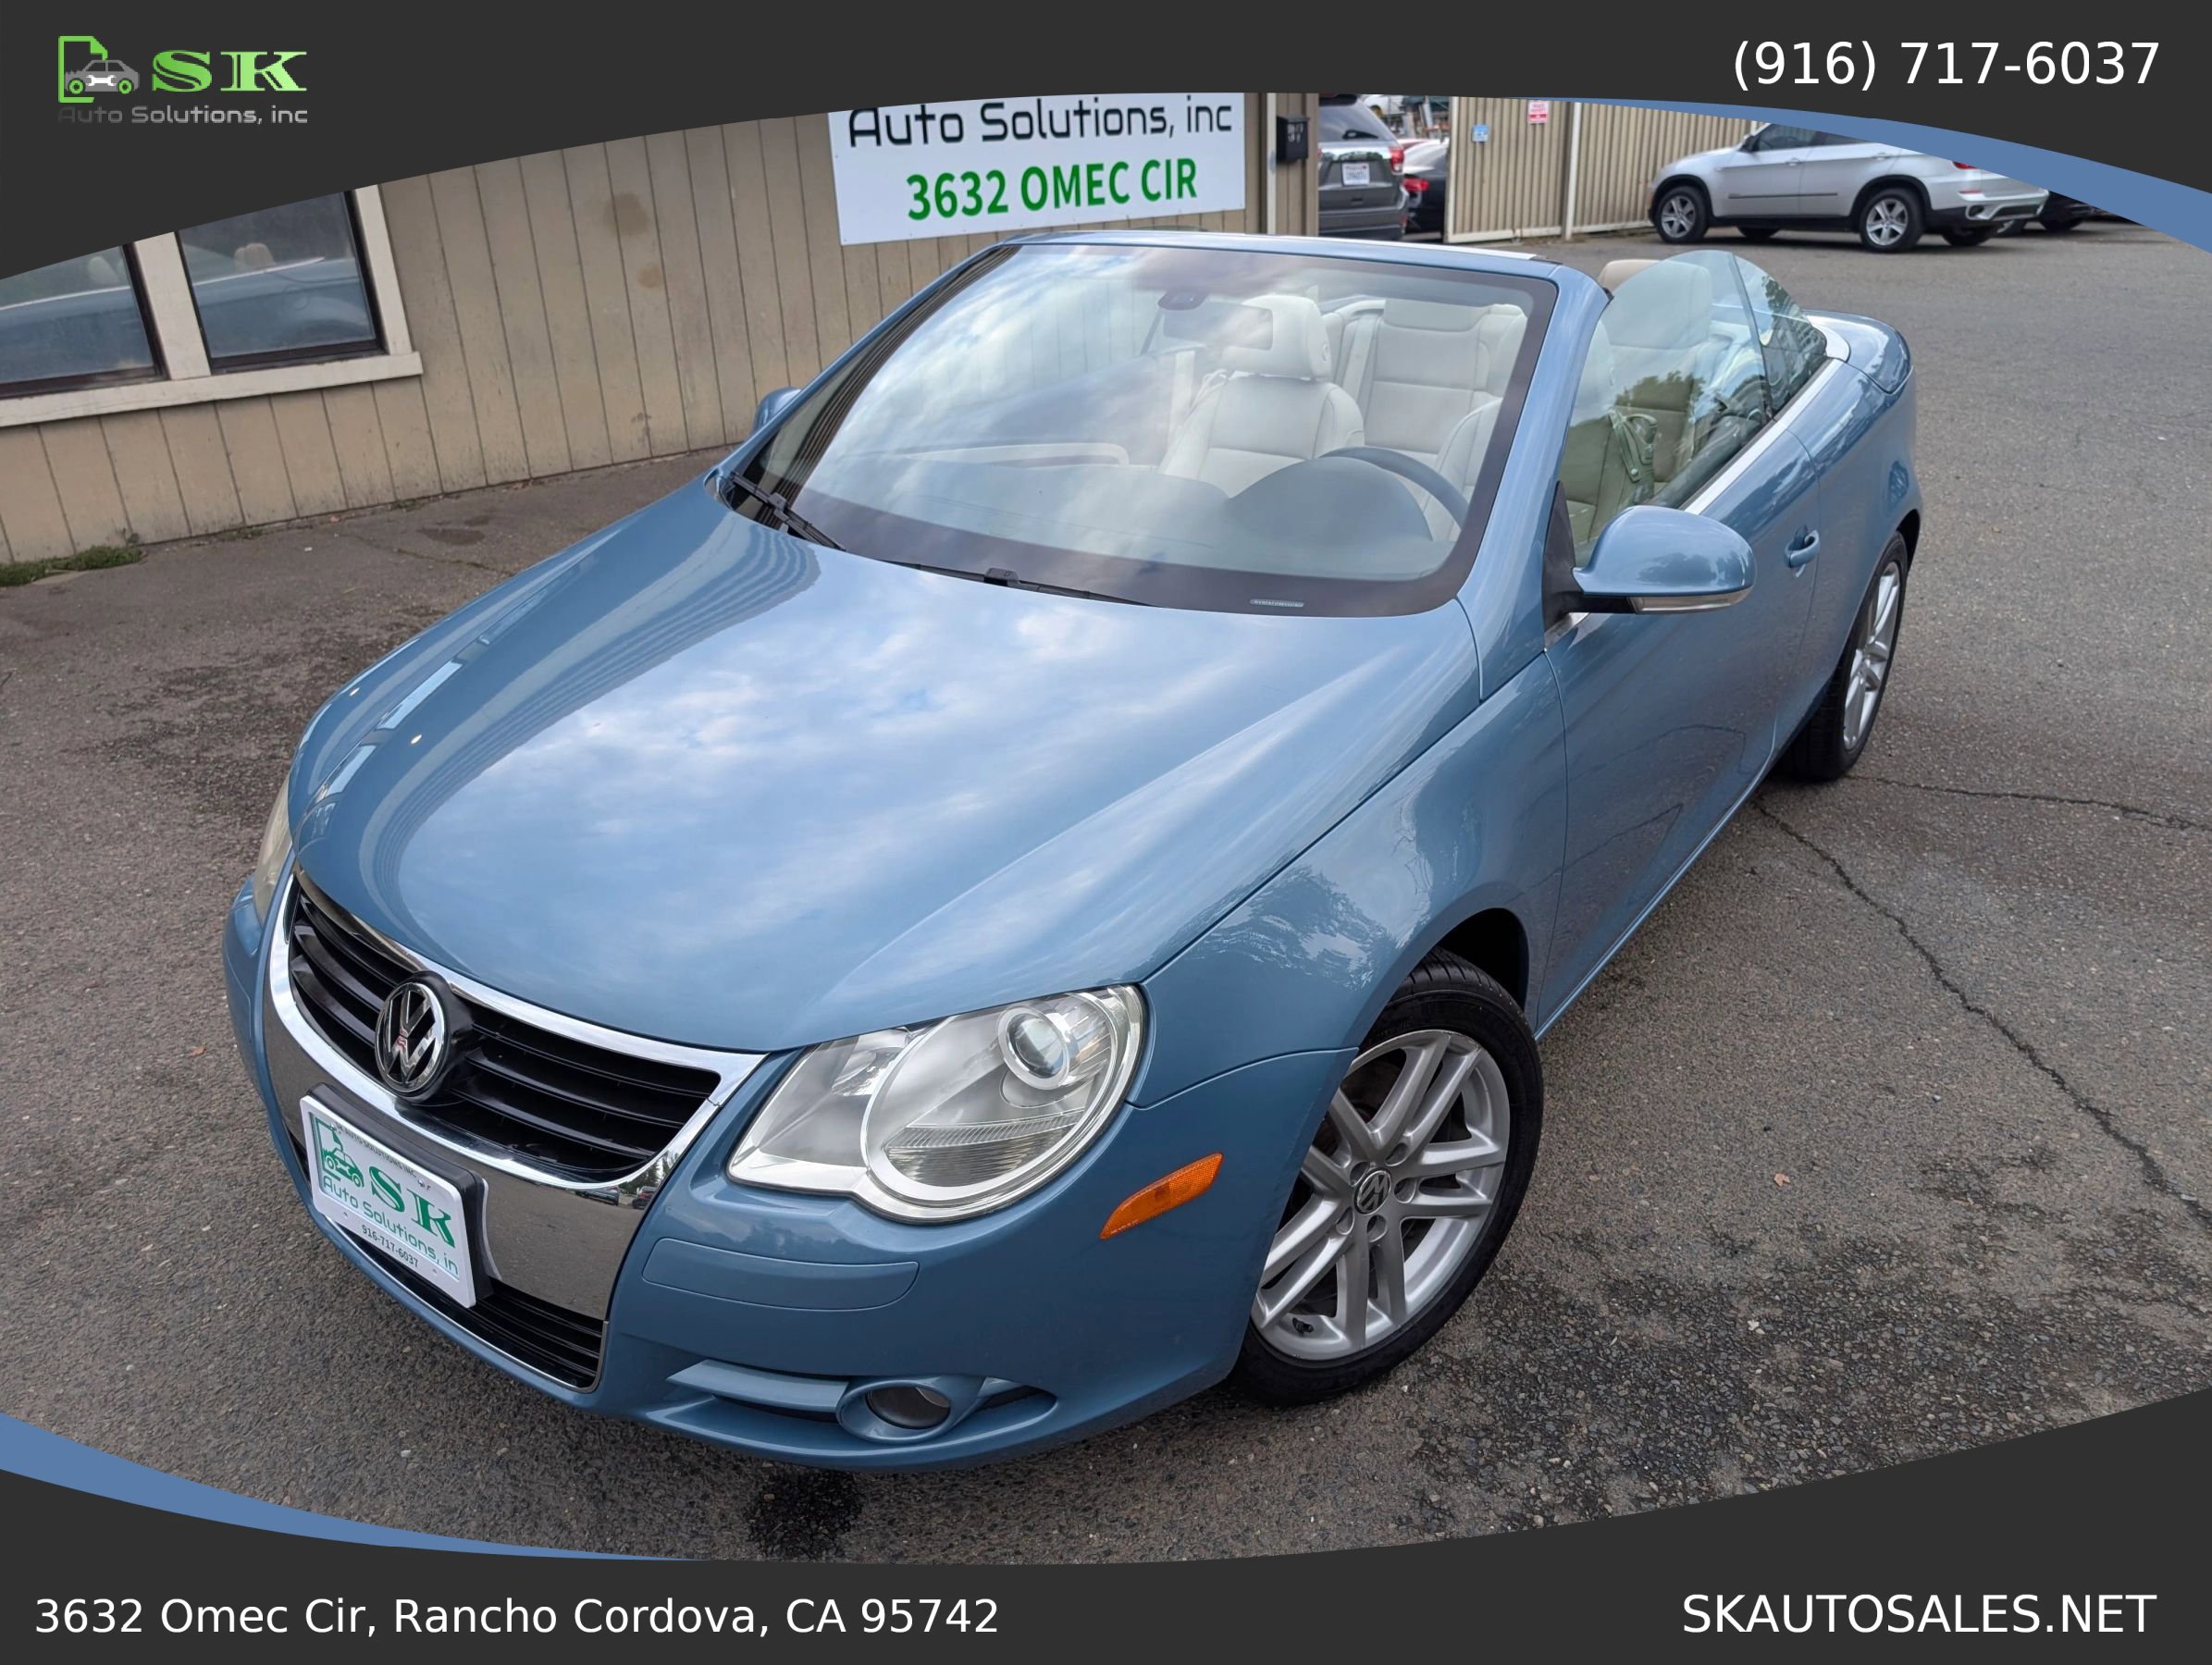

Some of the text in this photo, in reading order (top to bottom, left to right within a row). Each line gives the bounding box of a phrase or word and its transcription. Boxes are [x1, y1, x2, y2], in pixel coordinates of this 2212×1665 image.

[849, 94, 1232, 147] Auto Solutions, inc
[907, 157, 1198, 220] 3632 OMEC CIR
[324, 1176, 358, 1208] Auto
[363, 1201, 439, 1264] Solutions,
[369, 1166, 455, 1249] SK
[362, 1225, 418, 1267] 916-717-6037
